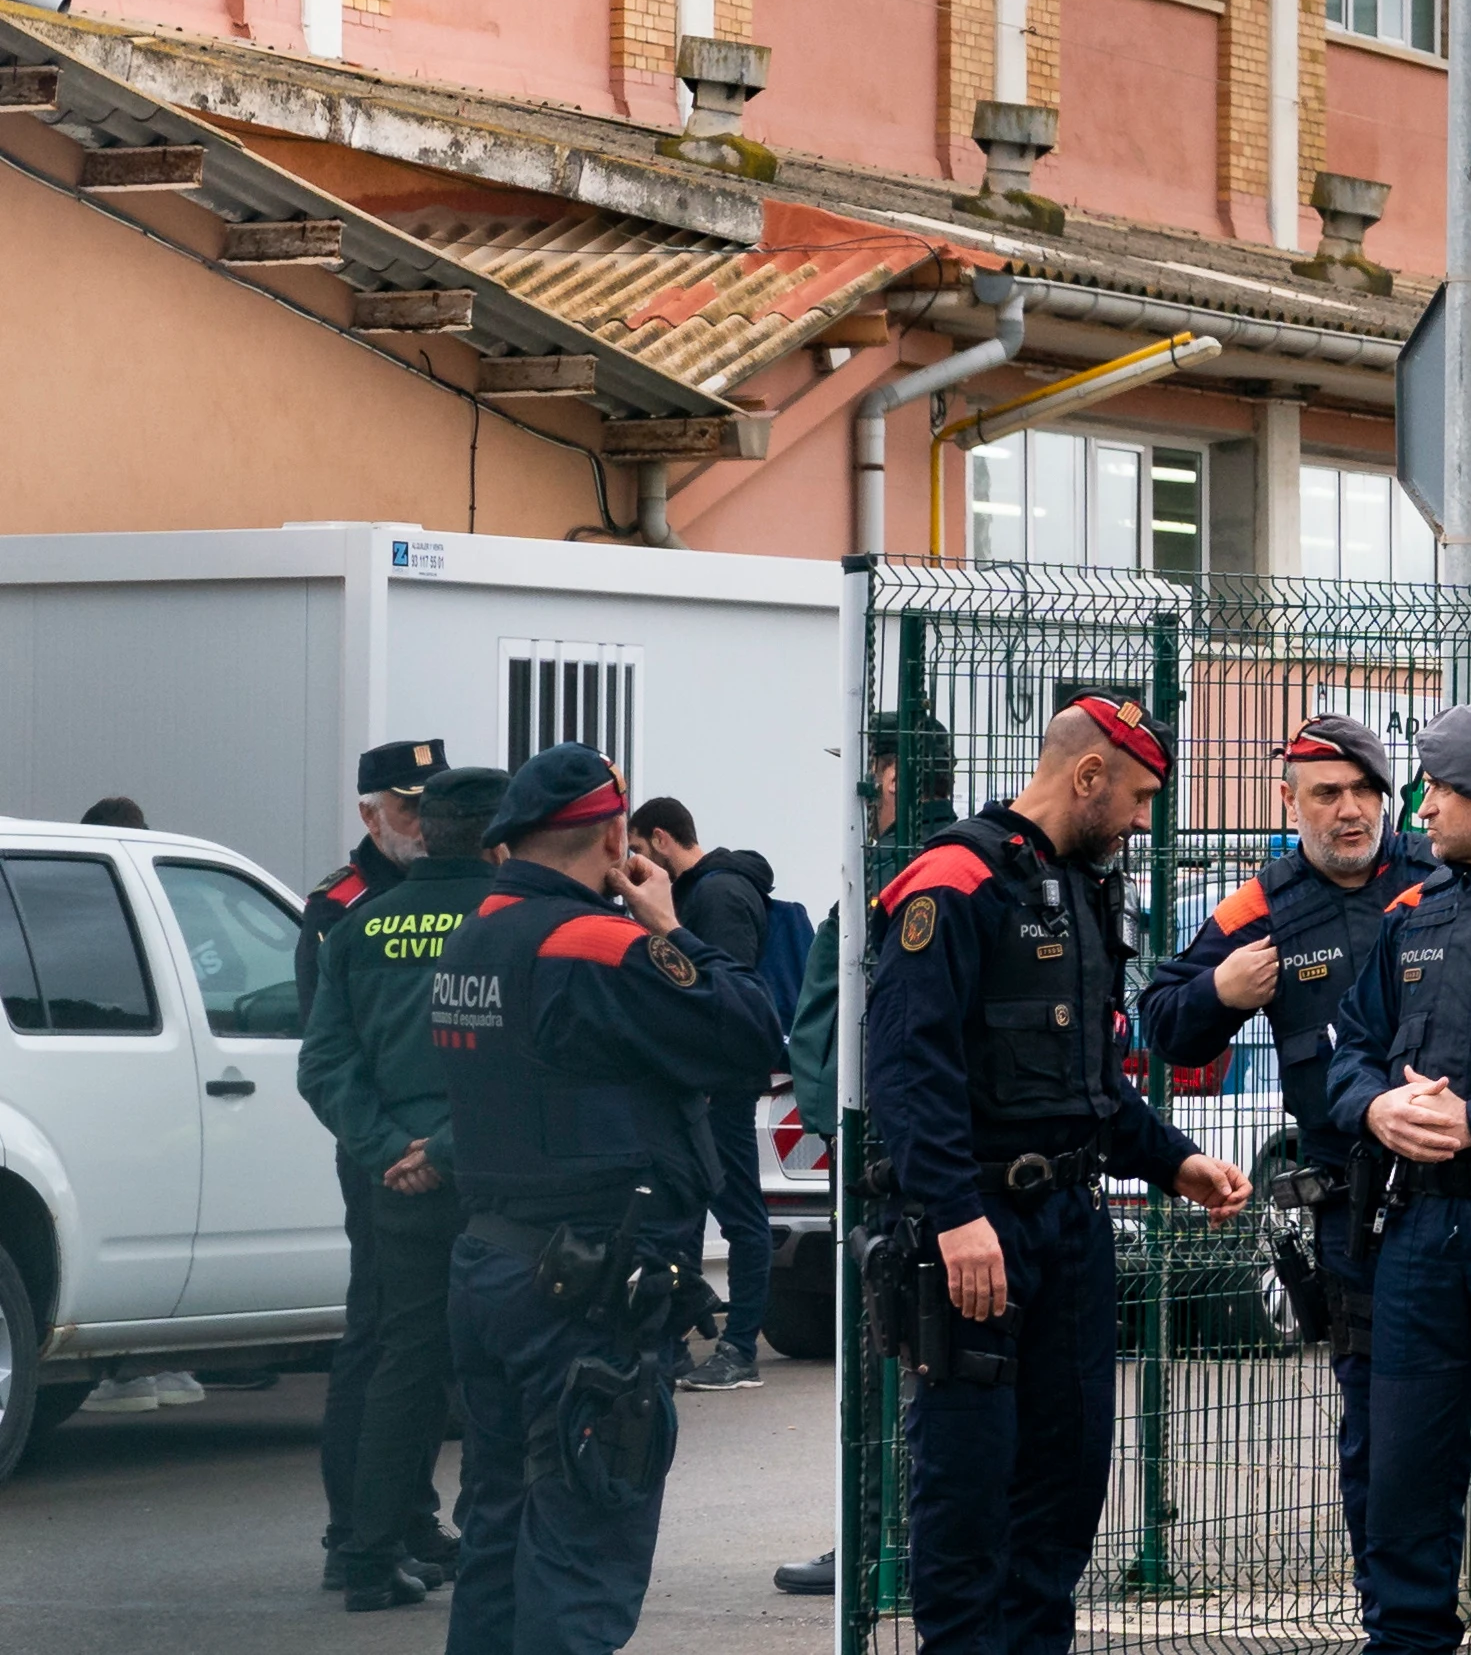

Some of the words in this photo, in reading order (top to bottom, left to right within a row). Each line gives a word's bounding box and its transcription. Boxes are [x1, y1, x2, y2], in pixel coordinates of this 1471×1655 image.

[1386, 711, 1427, 740] Ap
[365, 913, 463, 936] GUARDI
[1020, 924, 1069, 937] POLA
[1283, 947, 1344, 970] POLICIA
[1401, 948, 1443, 965] POLICIA
[432, 972, 502, 1008] POLICIA
